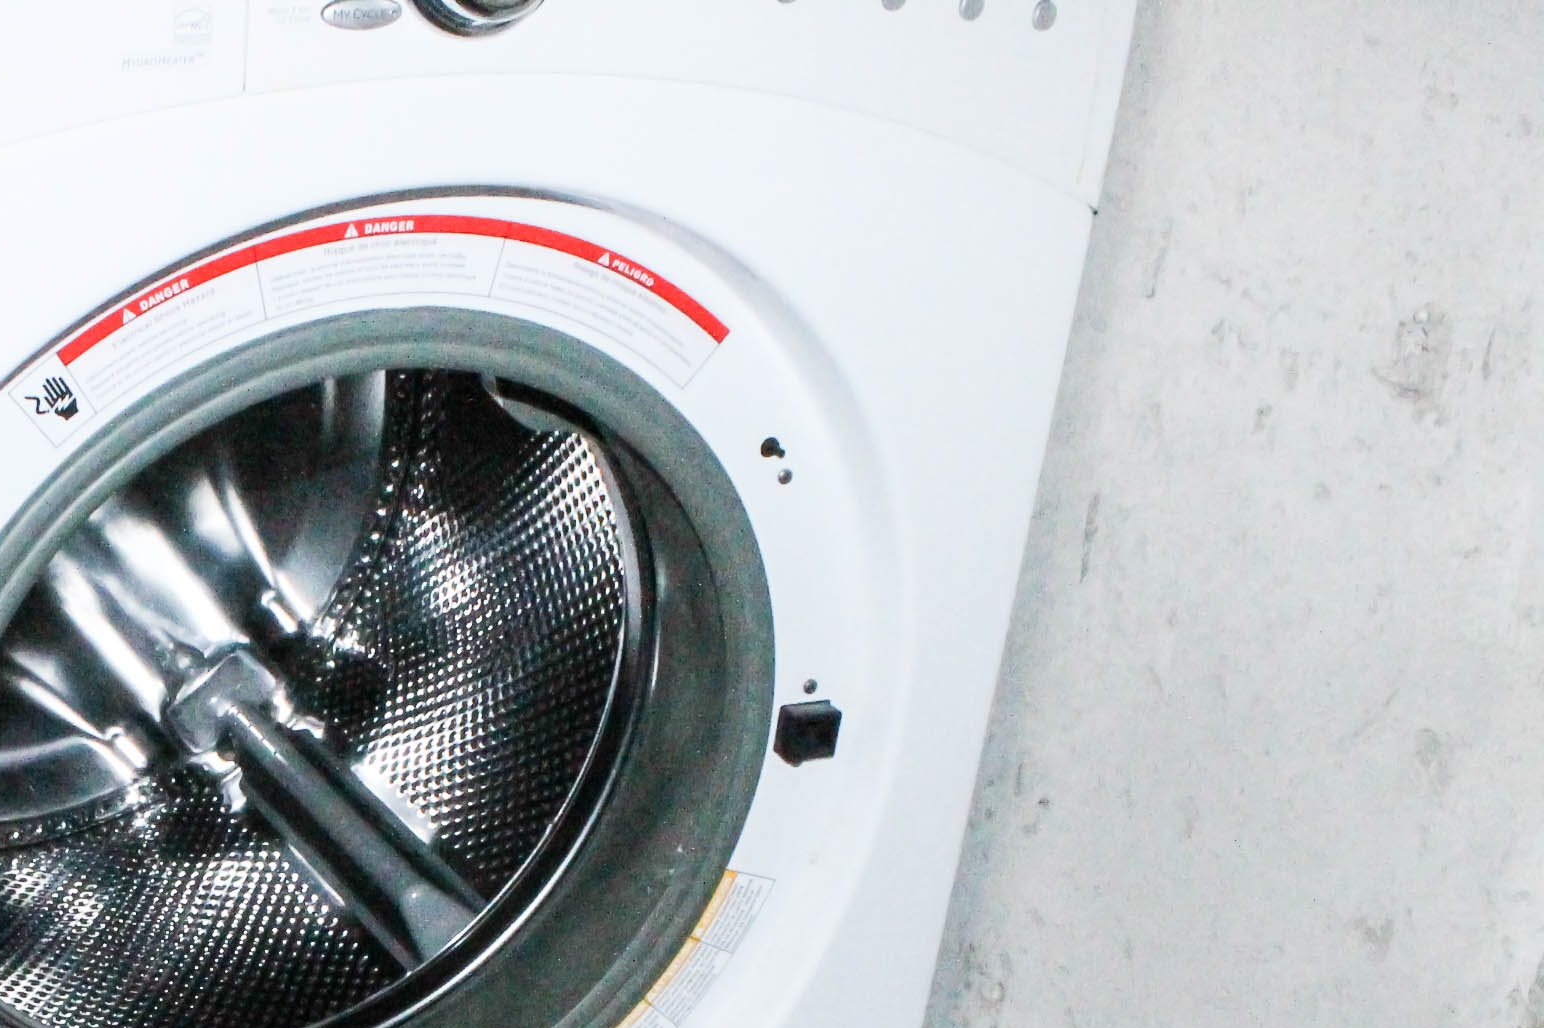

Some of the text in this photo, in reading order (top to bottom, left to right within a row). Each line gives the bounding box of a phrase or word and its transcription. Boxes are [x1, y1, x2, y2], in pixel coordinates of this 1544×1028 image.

[364, 219, 414, 235] DANGER
[612, 258, 655, 287] PELIGRO
[139, 278, 190, 312] DANGER
